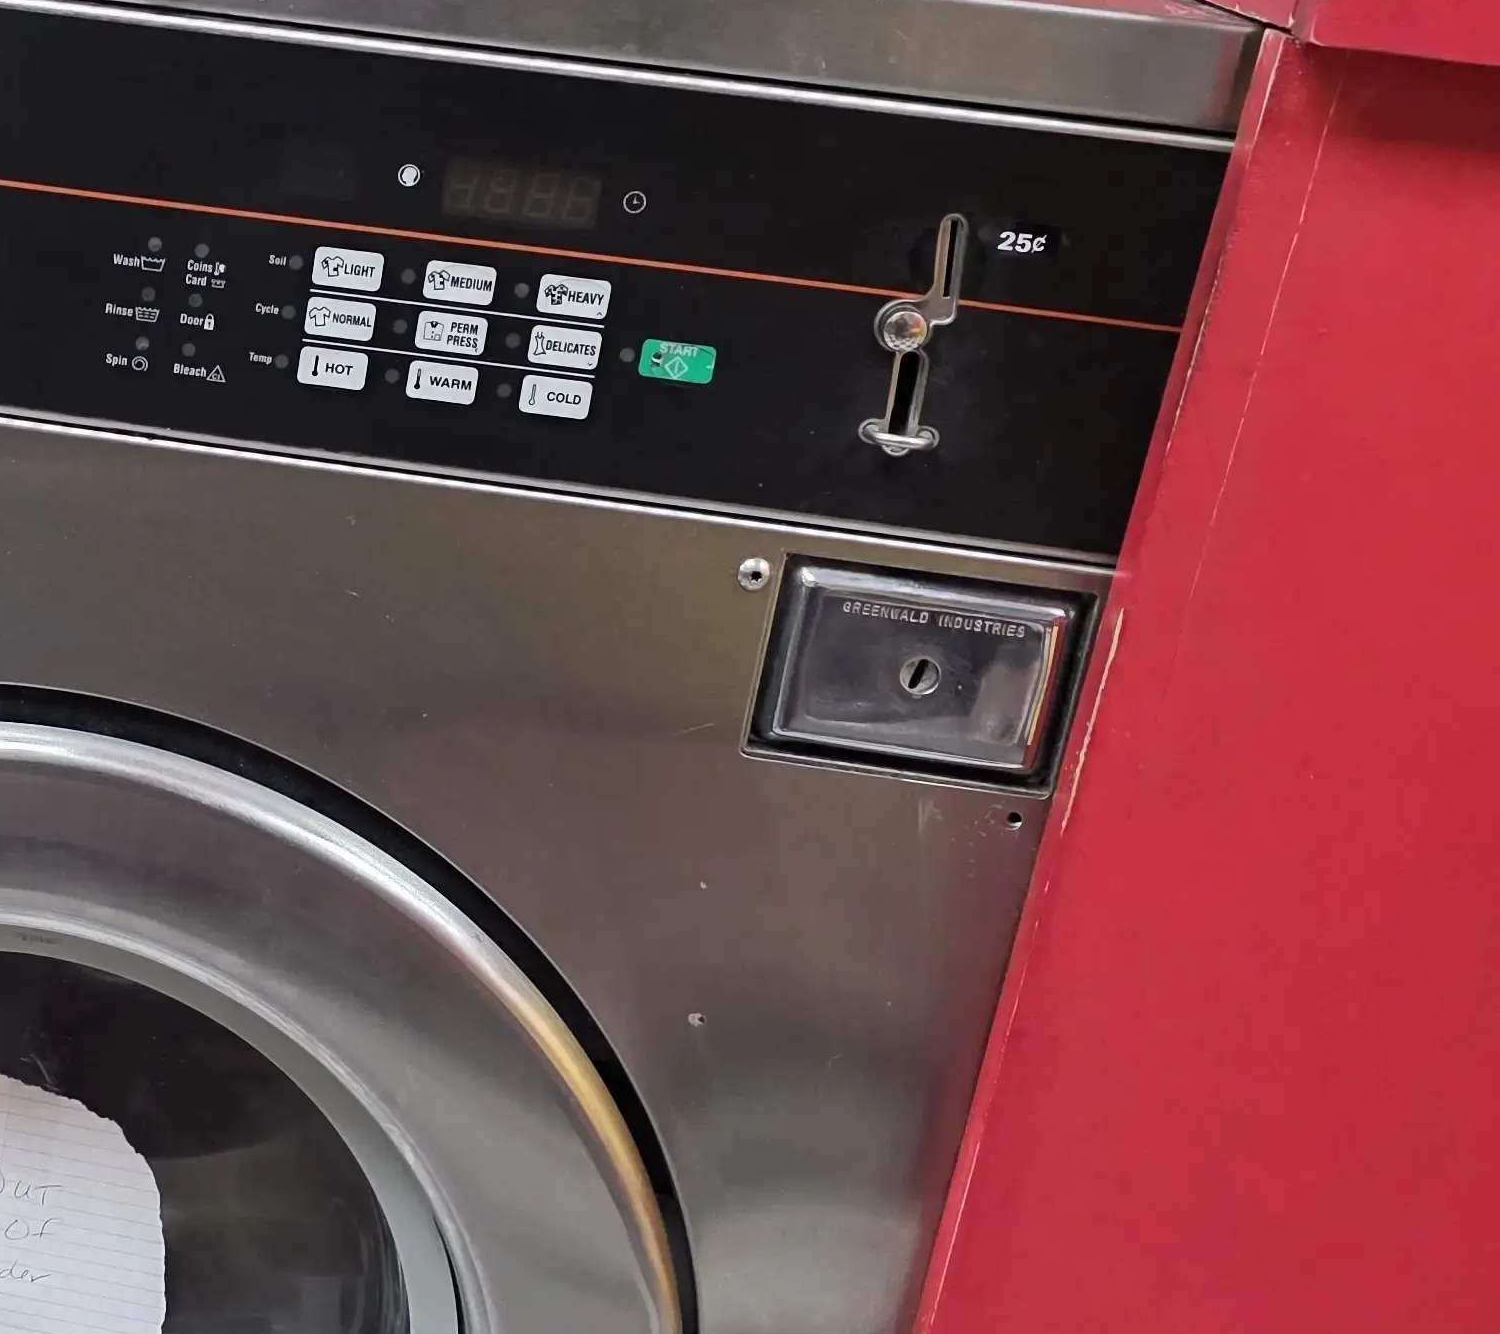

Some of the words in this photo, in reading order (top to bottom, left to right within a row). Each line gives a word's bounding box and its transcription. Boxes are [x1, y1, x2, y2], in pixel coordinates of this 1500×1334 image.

[998, 232, 1047, 253] 25¢
[113, 253, 140, 267] Wash
[187, 260, 212, 273] Coins
[269, 255, 286, 266] Soil
[344, 263, 376, 278] LIGHT
[186, 274, 206, 286] Card
[451, 277, 493, 292] MEDIUM
[568, 290, 604, 306] HEAVY
[105, 303, 133, 317] Rinse
[256, 303, 279, 315] Cycle
[180, 314, 203, 326] Door
[332, 313, 372, 328] NORMAL
[451, 322, 479, 335] PERM
[447, 335, 478, 349] PRESS
[545, 339, 596, 357] DELICATES
[660, 342, 699, 357] START
[106, 354, 128, 367] Spin
[249, 352, 272, 365] Temp
[174, 364, 206, 378] Bleach
[325, 363, 353, 376] HOT
[430, 376, 472, 391] WARM
[547, 392, 581, 405] COLD
[843, 601, 928, 624] GREENWALD
[938, 614, 1025, 638] INDUSTRIES
